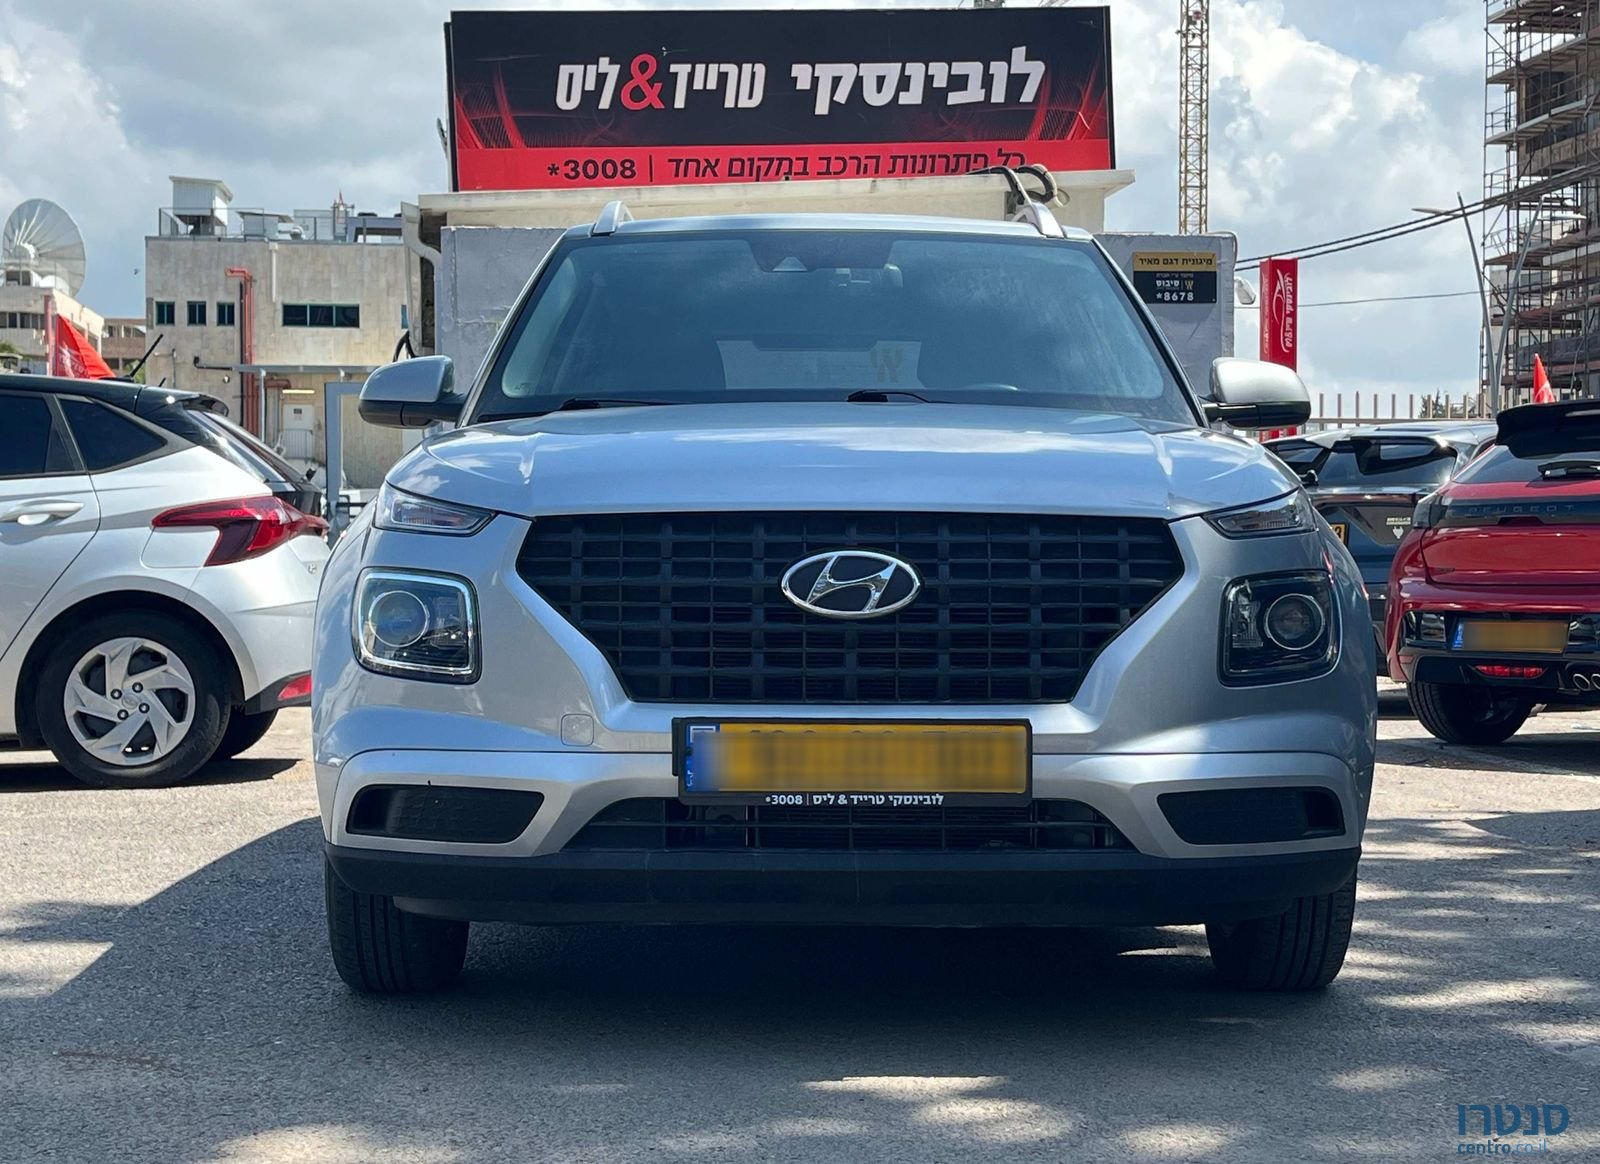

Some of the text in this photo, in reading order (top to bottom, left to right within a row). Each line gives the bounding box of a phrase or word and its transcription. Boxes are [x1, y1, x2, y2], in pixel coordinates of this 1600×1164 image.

[791, 46, 1045, 115] לובינסקי
[668, 157, 720, 178] אחד
[728, 156, 808, 182] במקום
[816, 155, 880, 175] הרכב
[887, 152, 989, 174] פתרונות
[1138, 257, 1160, 265] מאיר
[1162, 257, 1179, 265] דגם
[1468, 504, 1575, 513] PEUGEOT
[812, 793, 835, 805] ליס
[837, 794, 848, 805] &
[850, 794, 885, 805] טרייד
[888, 793, 944, 806] לובינסקי
